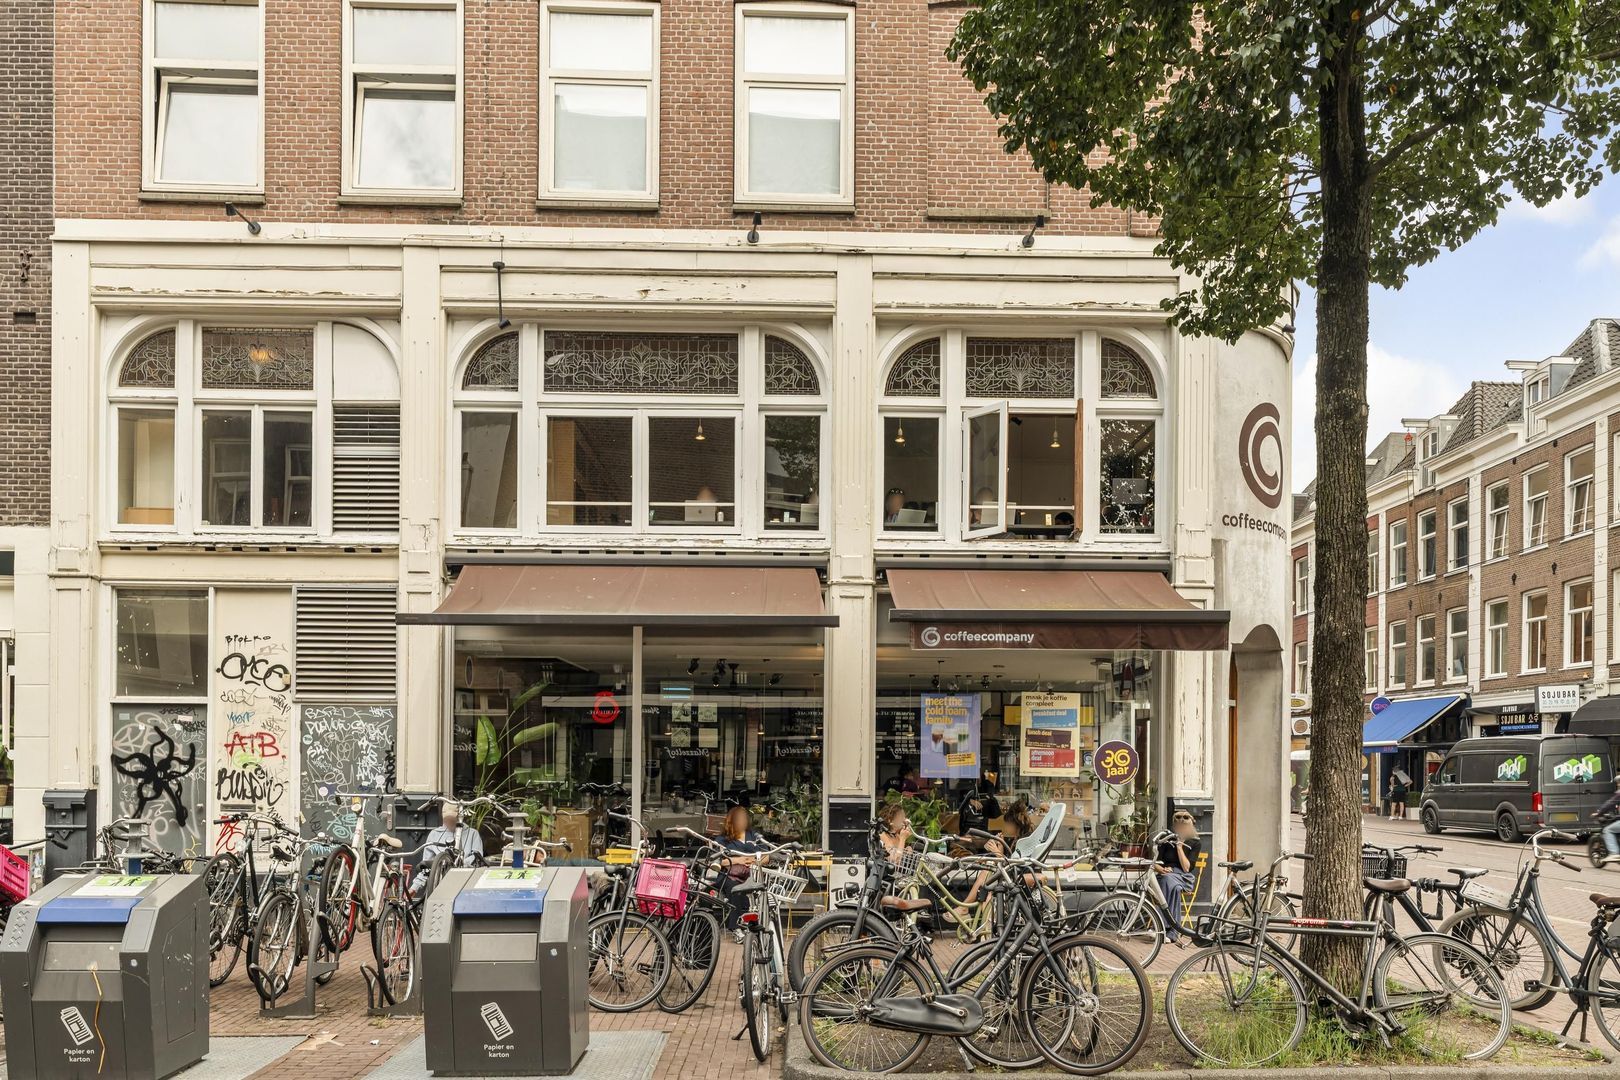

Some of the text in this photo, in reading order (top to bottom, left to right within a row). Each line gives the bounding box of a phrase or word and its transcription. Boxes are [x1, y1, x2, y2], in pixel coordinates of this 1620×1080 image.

[943, 631, 1035, 643] coffeecompany
[1541, 690, 1577, 699] SOJU BAR
[925, 696, 946, 706] meet
[925, 706, 968, 717] cold foam
[1514, 714, 1526, 724] BAR
[1101, 749, 1131, 769] 30
[1106, 766, 1129, 778] jaar
